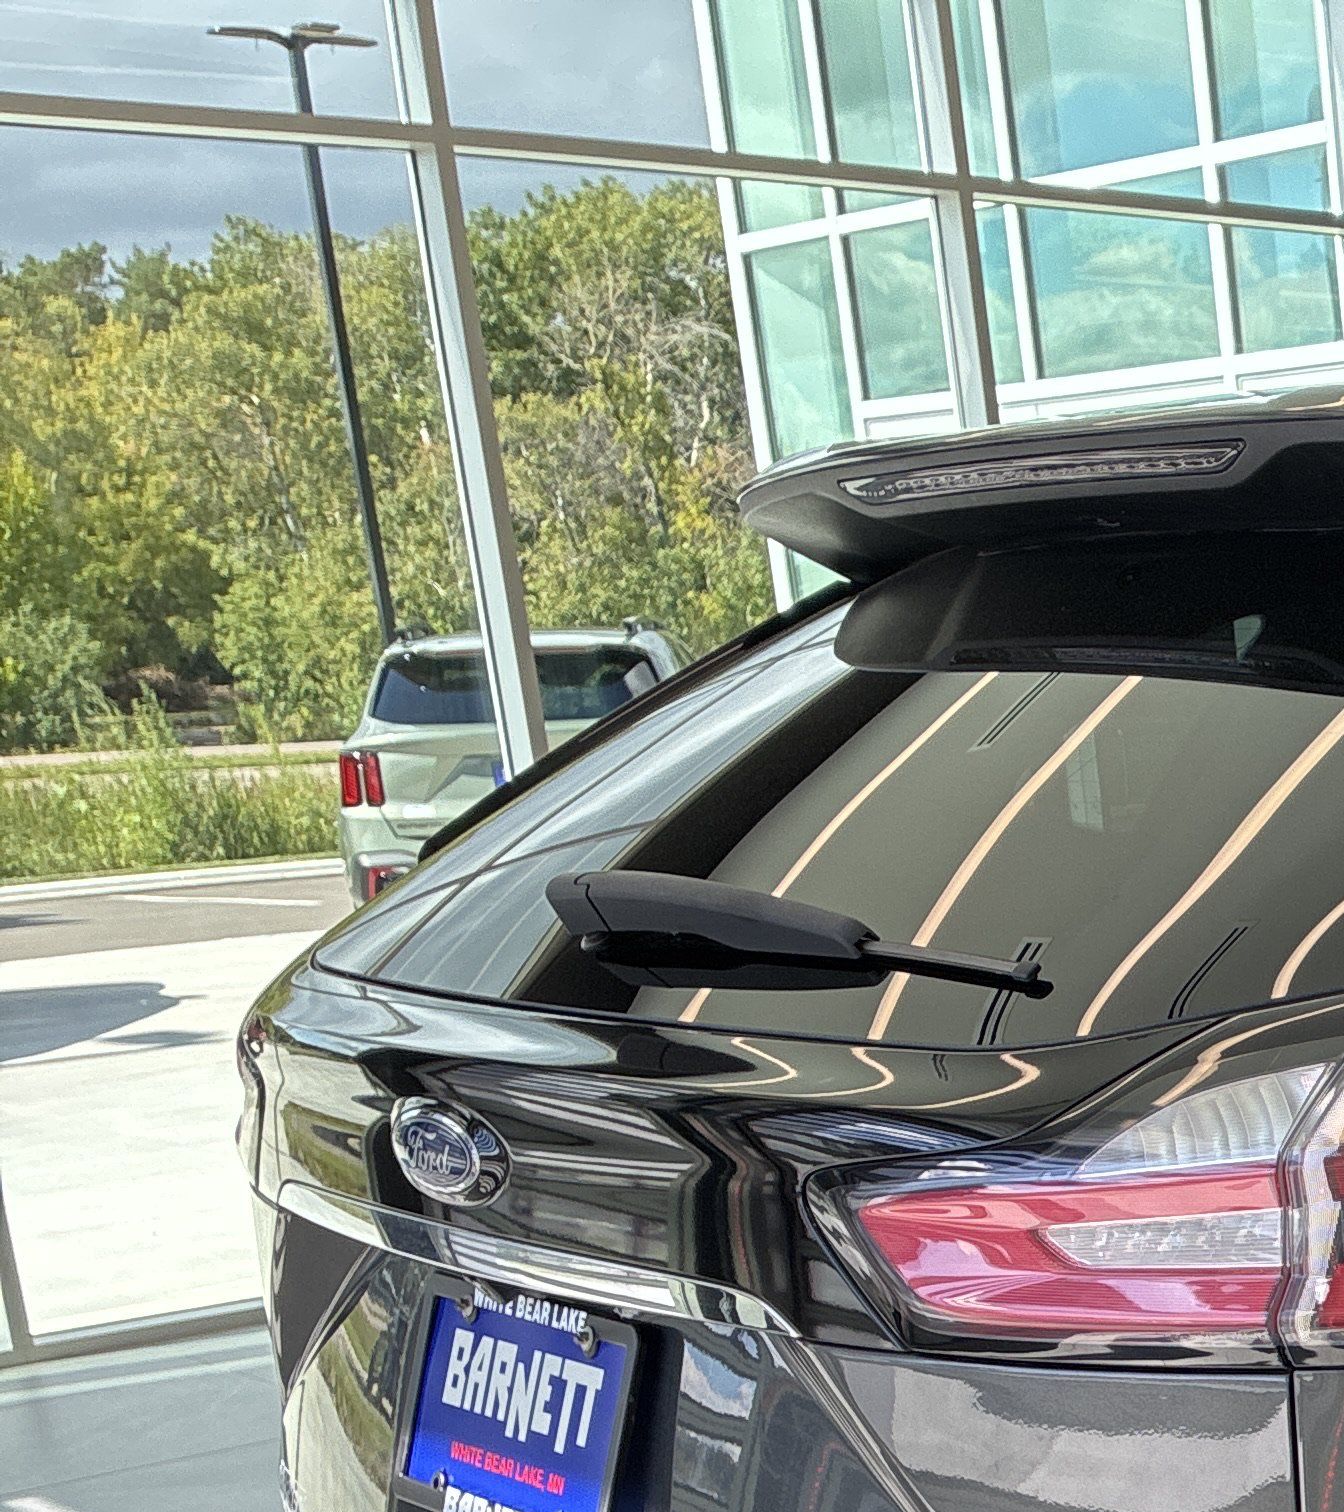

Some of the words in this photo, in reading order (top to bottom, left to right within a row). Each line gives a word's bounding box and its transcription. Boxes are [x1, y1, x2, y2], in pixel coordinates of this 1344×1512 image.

[402, 1125, 453, 1176] Ford
[515, 1294, 551, 1327] BEAR
[551, 1303, 588, 1335] LAKE
[442, 1327, 605, 1454] BARNETT
[450, 1440, 484, 1469] WHITE
[484, 1451, 514, 1479] BEAR
[514, 1461, 545, 1493] LAKE,
